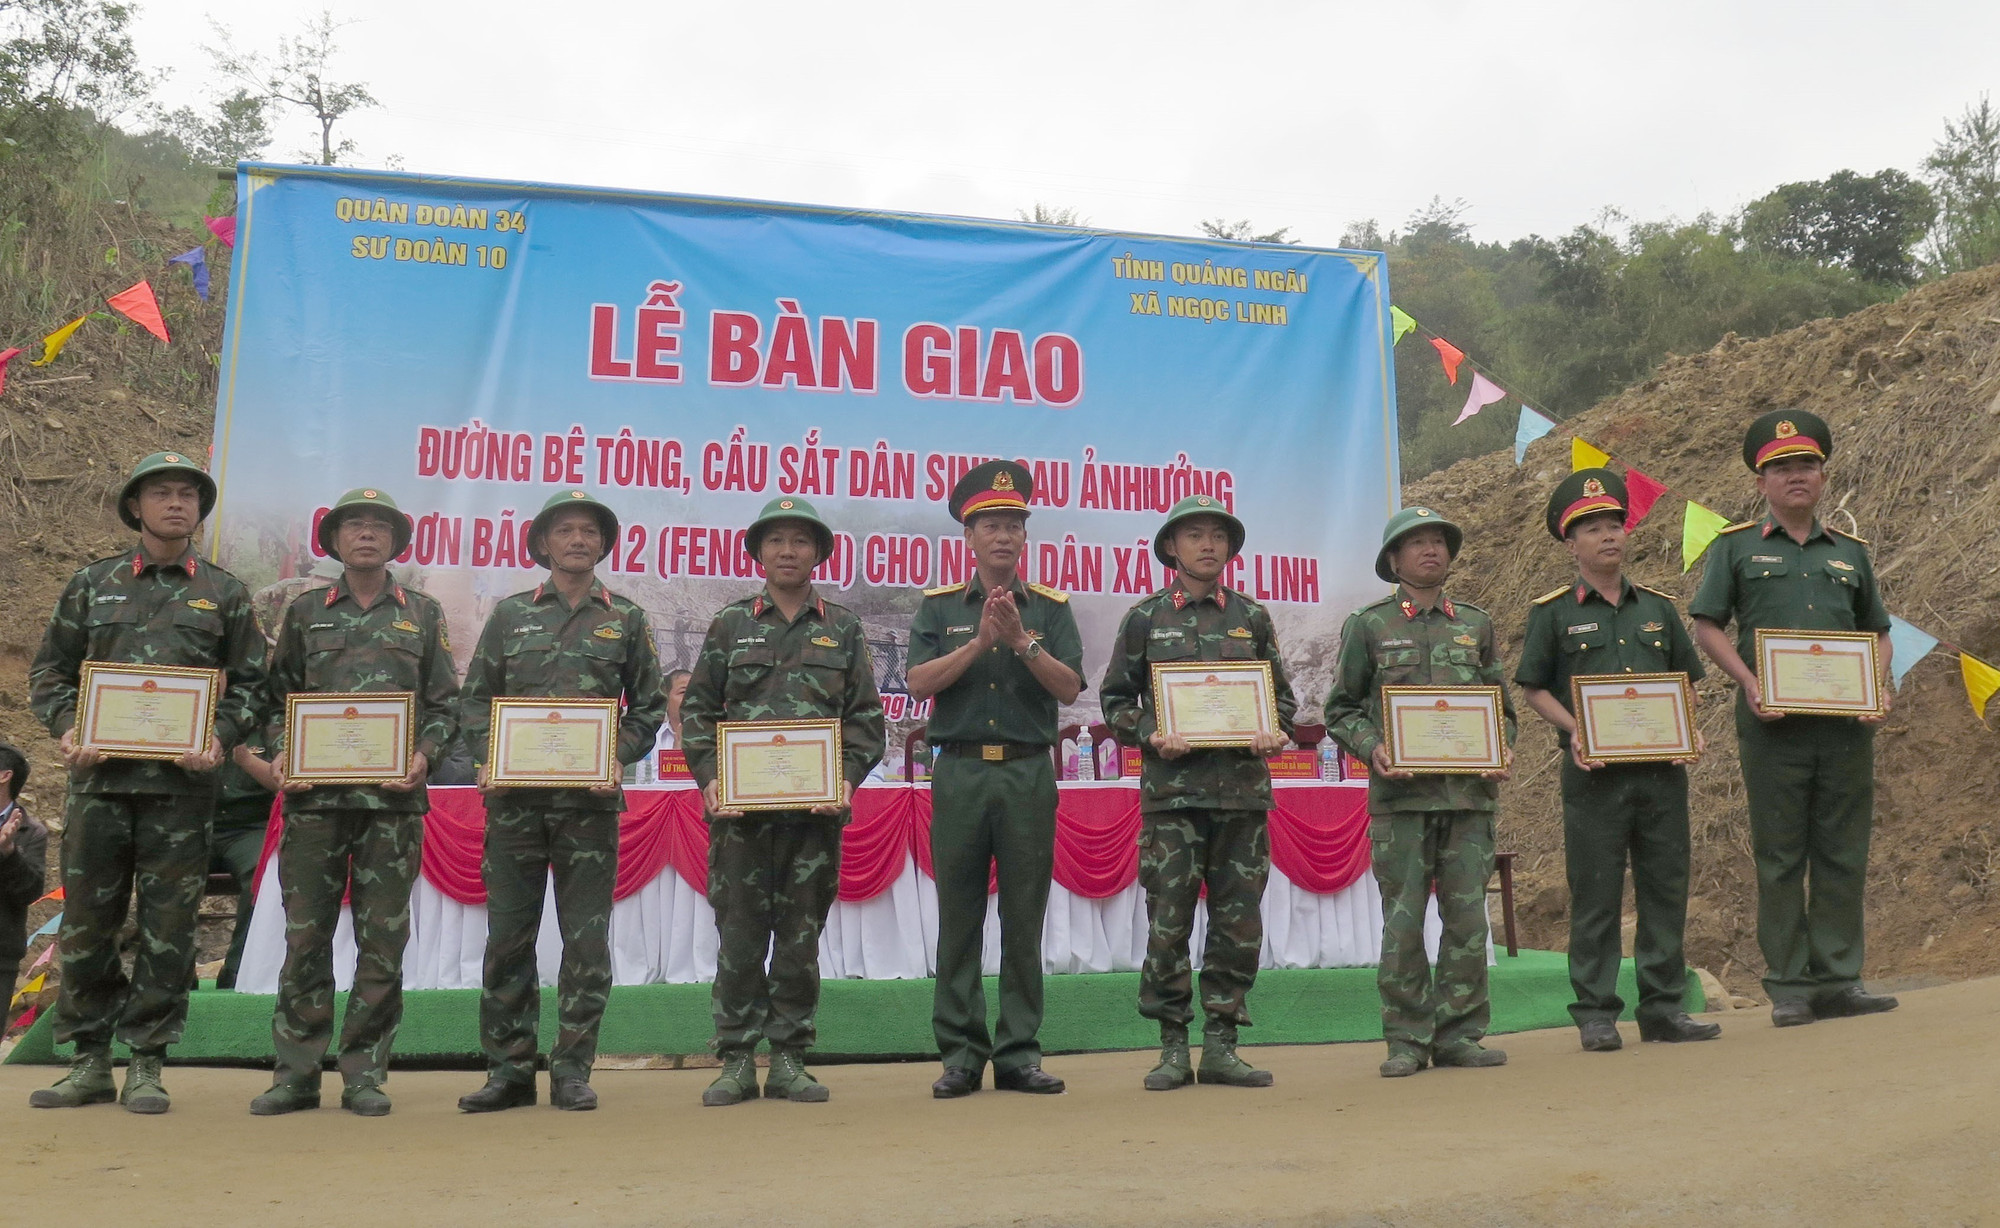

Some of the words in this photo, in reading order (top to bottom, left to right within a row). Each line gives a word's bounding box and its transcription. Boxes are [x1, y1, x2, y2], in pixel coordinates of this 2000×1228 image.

[335, 197, 409, 224] QUÂN
[415, 203, 488, 230] ĐOÀN
[494, 209, 527, 234] 34
[351, 235, 391, 260] SƯ
[394, 236, 468, 266] ĐOÀN
[476, 246, 508, 269] 10
[1111, 252, 1165, 282] TỈNH
[1171, 258, 1249, 288] QUẢNG
[1253, 268, 1308, 294] NGÃI
[1129, 290, 1162, 316] XÃ
[1167, 296, 1230, 324] NGỌC
[1236, 301, 1288, 326] LINH
[590, 282, 684, 380] LỄ
[709, 299, 879, 394] BÀN
[904, 323, 1080, 405] GIAO
[418, 420, 533, 483] ĐƯỜNG
[542, 426, 586, 485] BÊ
[596, 428, 691, 495] TÔNG,
[703, 427, 767, 493] CẦU
[778, 429, 840, 496] SẮT
[849, 440, 915, 500] DÂN
[925, 454, 1001, 502] SI
[1014, 459, 1069, 508] AU
[658, 526, 854, 588] (FENGN)
[866, 535, 929, 586] CHO
[1038, 534, 1103, 593] DÂN
[1112, 538, 1154, 595] XÃ
[1254, 554, 1320, 603] LINH
